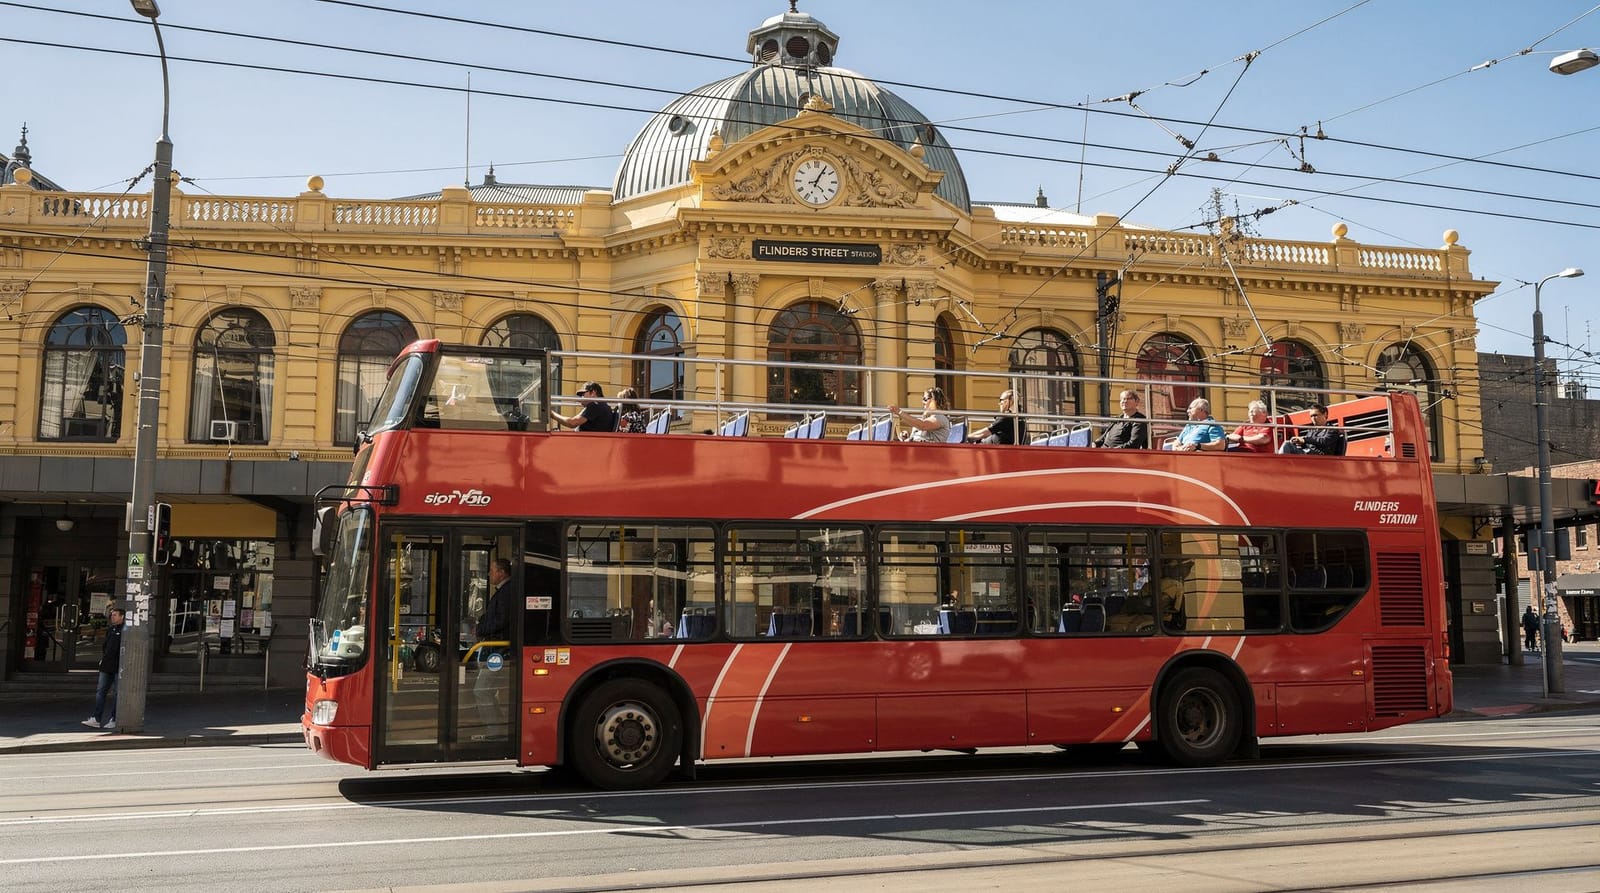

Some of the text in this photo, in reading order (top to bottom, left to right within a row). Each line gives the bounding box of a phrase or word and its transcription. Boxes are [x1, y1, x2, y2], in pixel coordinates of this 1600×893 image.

[759, 246, 809, 256] FLINDERS
[811, 247, 849, 257] STREET
[1353, 500, 1400, 512] FLINDERS
[1379, 513, 1418, 525] STATION
